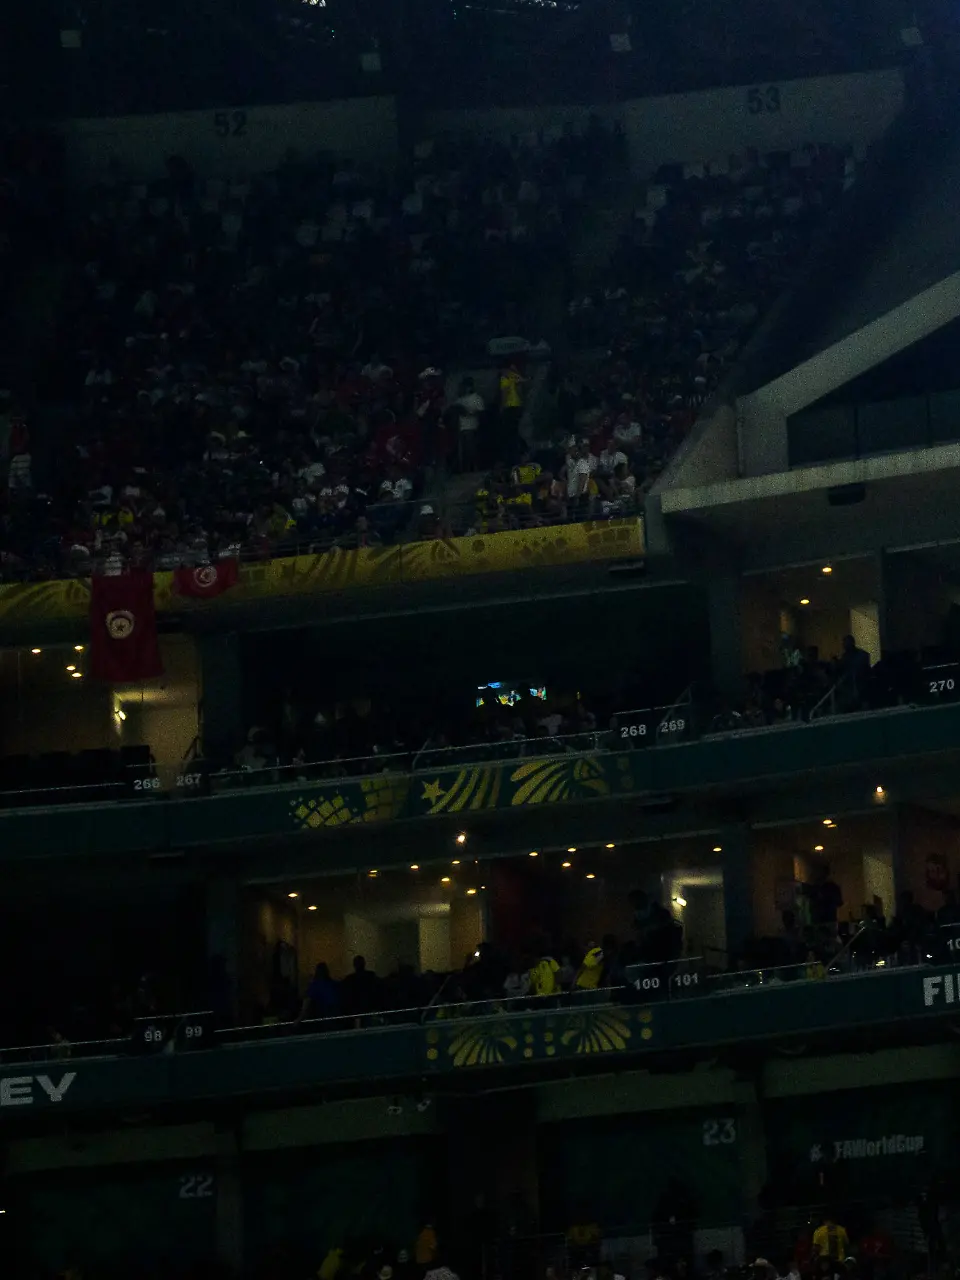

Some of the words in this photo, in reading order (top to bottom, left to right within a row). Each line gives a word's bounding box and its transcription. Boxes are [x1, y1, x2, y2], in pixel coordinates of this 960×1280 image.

[748, 86, 781, 114] 53
[215, 113, 247, 137] 52
[929, 678, 955, 694] 270
[620, 723, 647, 738] 268
[633, 977, 660, 991] 100
[673, 972, 700, 988] 101
[702, 1118, 737, 1146] 23
[178, 1173, 214, 1199] 22
